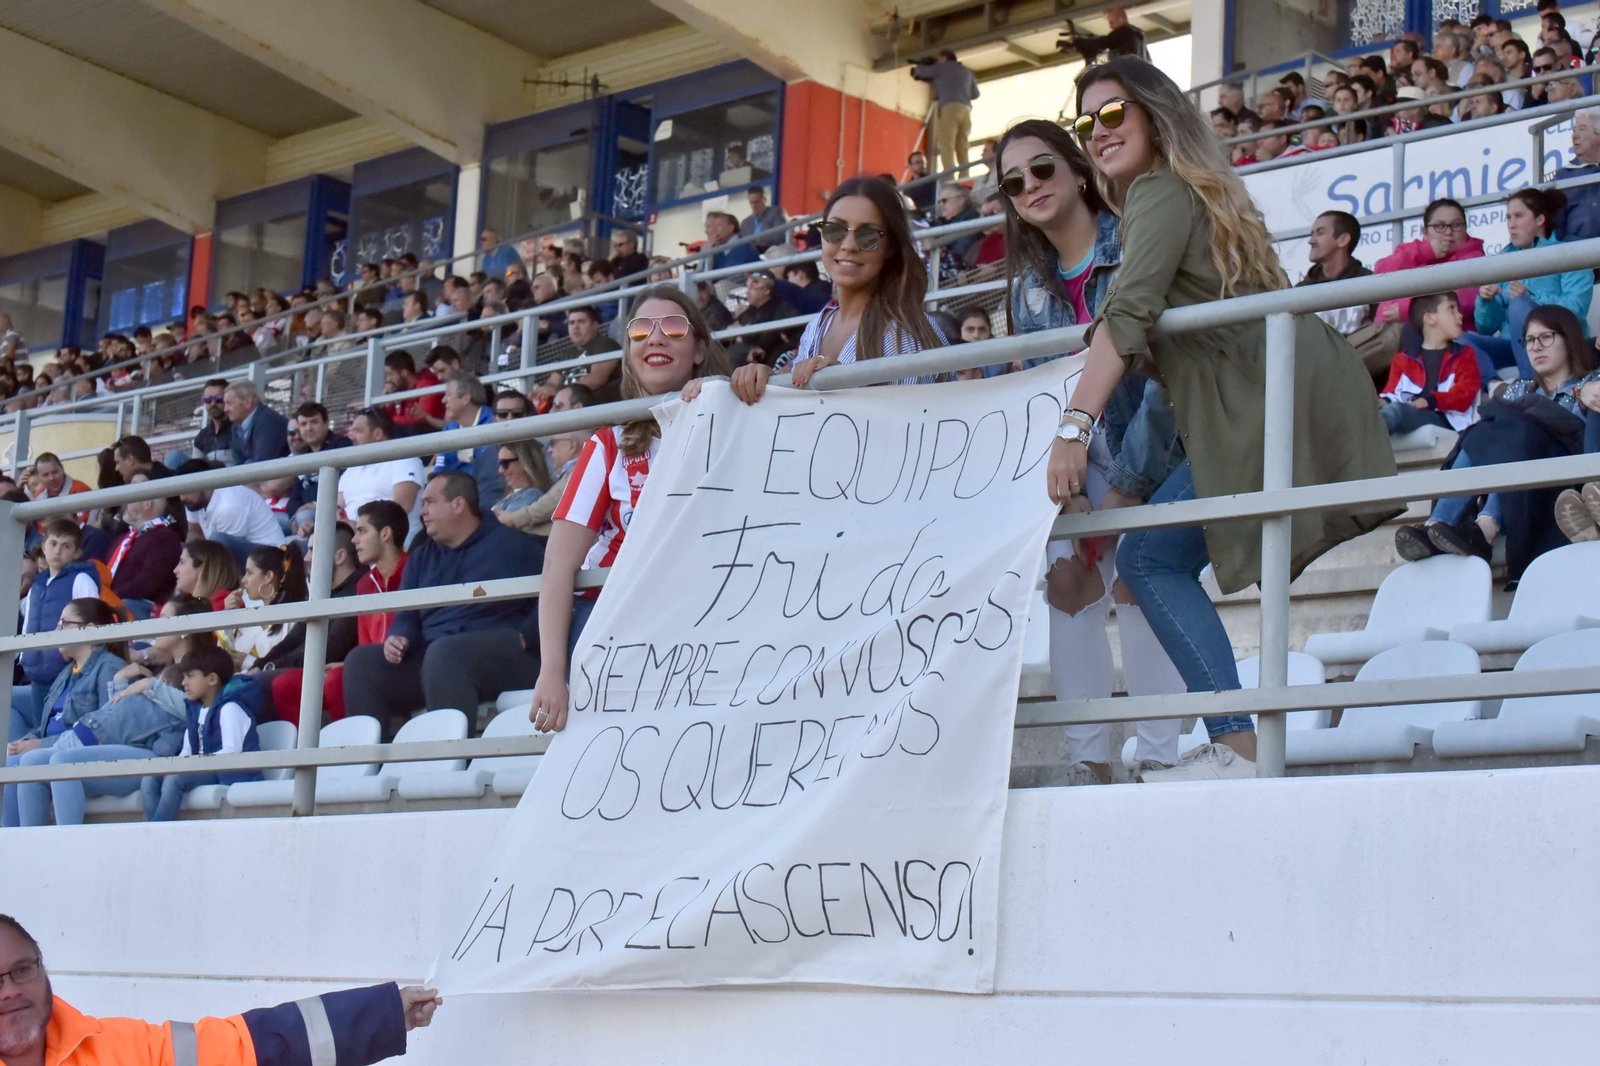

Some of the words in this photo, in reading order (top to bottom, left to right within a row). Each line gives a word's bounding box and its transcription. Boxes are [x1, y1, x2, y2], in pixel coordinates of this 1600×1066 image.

[763, 409, 1008, 504] EQUIPO
[561, 725, 660, 820] OS
[704, 856, 982, 956] ASCENSO!
